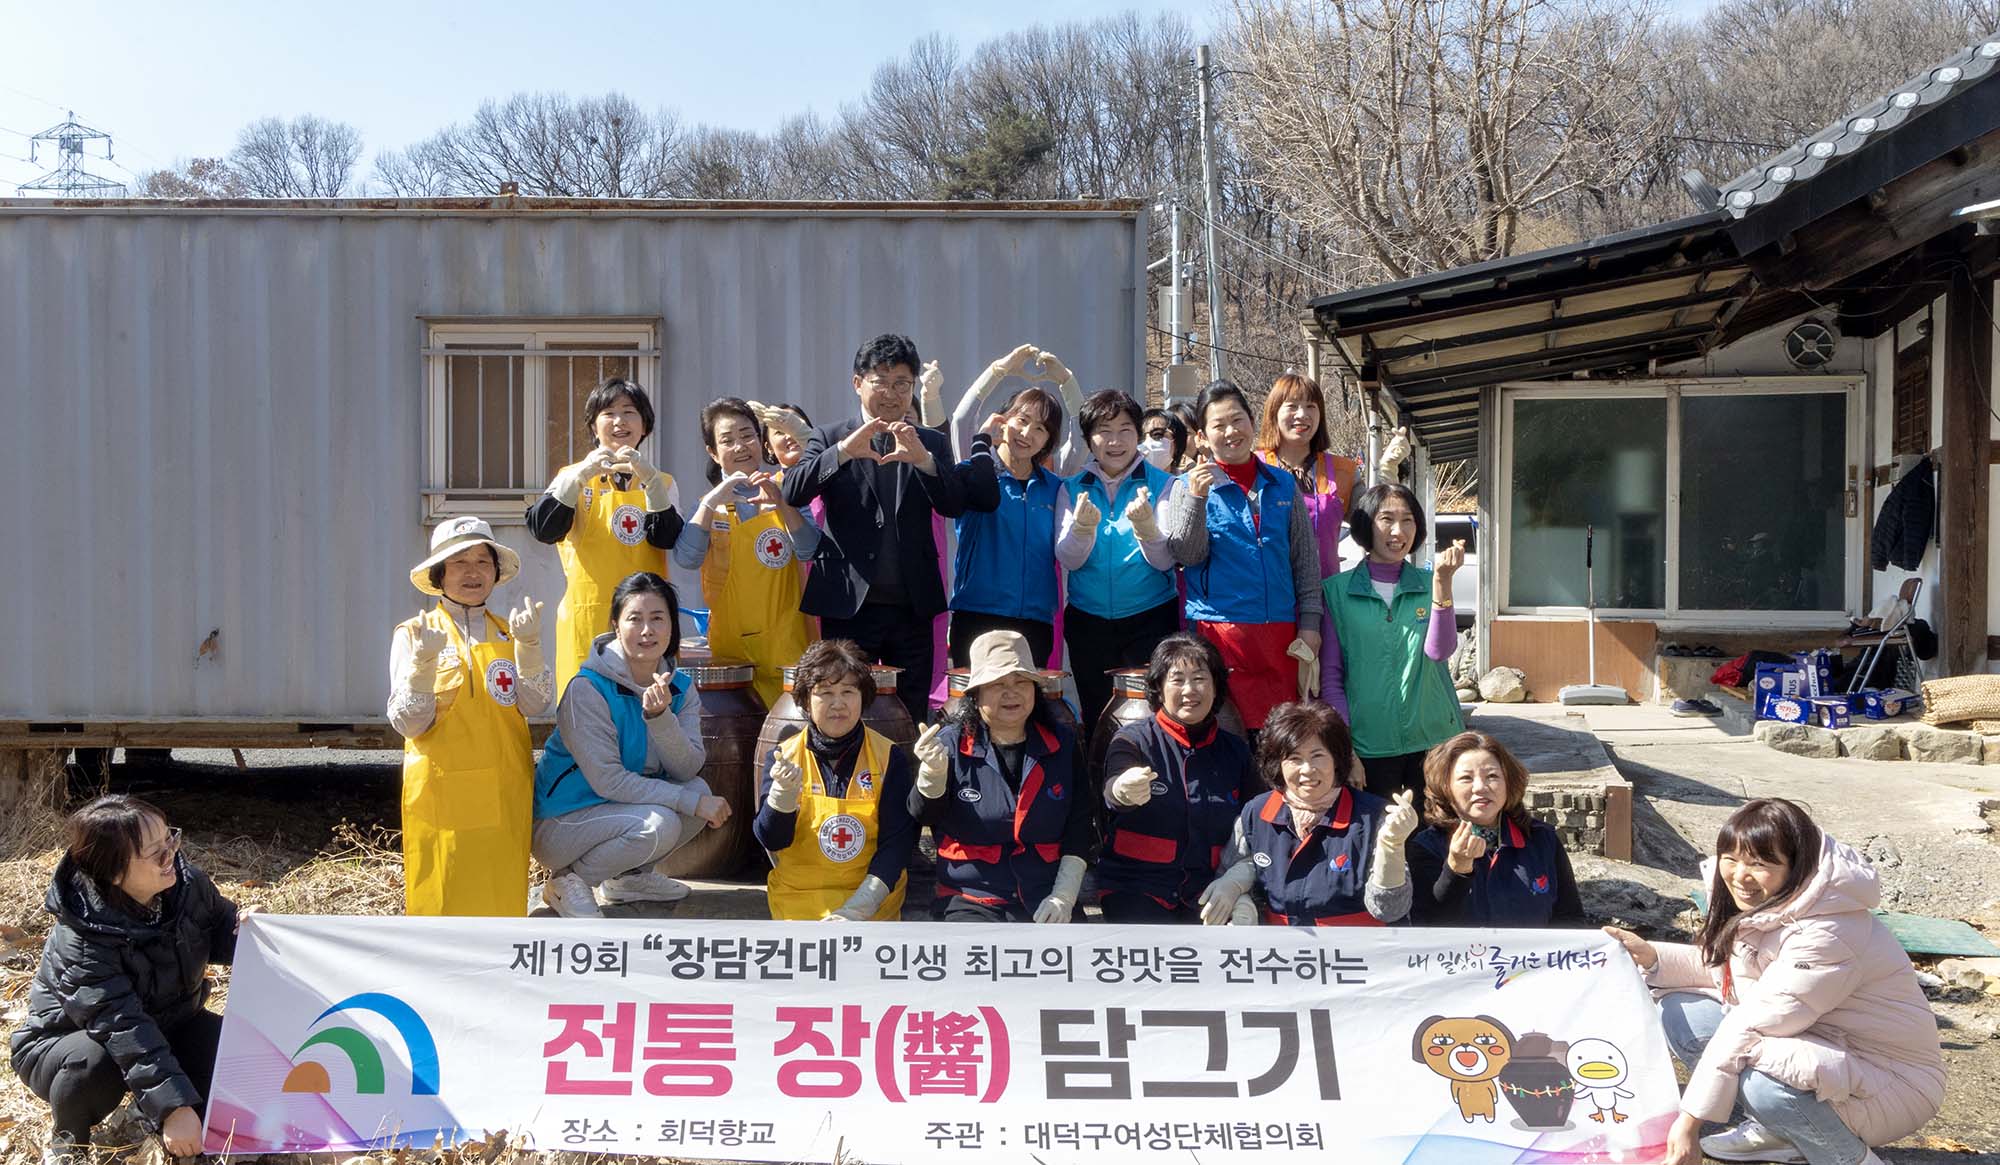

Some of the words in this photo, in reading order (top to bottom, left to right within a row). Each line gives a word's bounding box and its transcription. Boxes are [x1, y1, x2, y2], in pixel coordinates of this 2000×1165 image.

[510, 940, 628, 977] 제19회
[875, 944, 946, 981] 인생
[964, 945, 1073, 982] 최고의
[1091, 946, 1202, 983] 장맛을
[1219, 948, 1368, 984] 전수하는
[1407, 953, 1429, 972] 내
[1437, 951, 1484, 975] 일상이
[1488, 945, 1542, 990] 즐거운
[1547, 949, 1607, 972] 대덕구
[544, 1003, 736, 1096] 전통
[774, 1005, 1010, 1103] 장(醬)
[1040, 1008, 1341, 1100] 담그기
[562, 1118, 618, 1144] 장소
[658, 1119, 776, 1146] 회덕향교
[925, 1122, 984, 1149] 주관
[1024, 1122, 1324, 1150] 대덕구여성단체협의회
